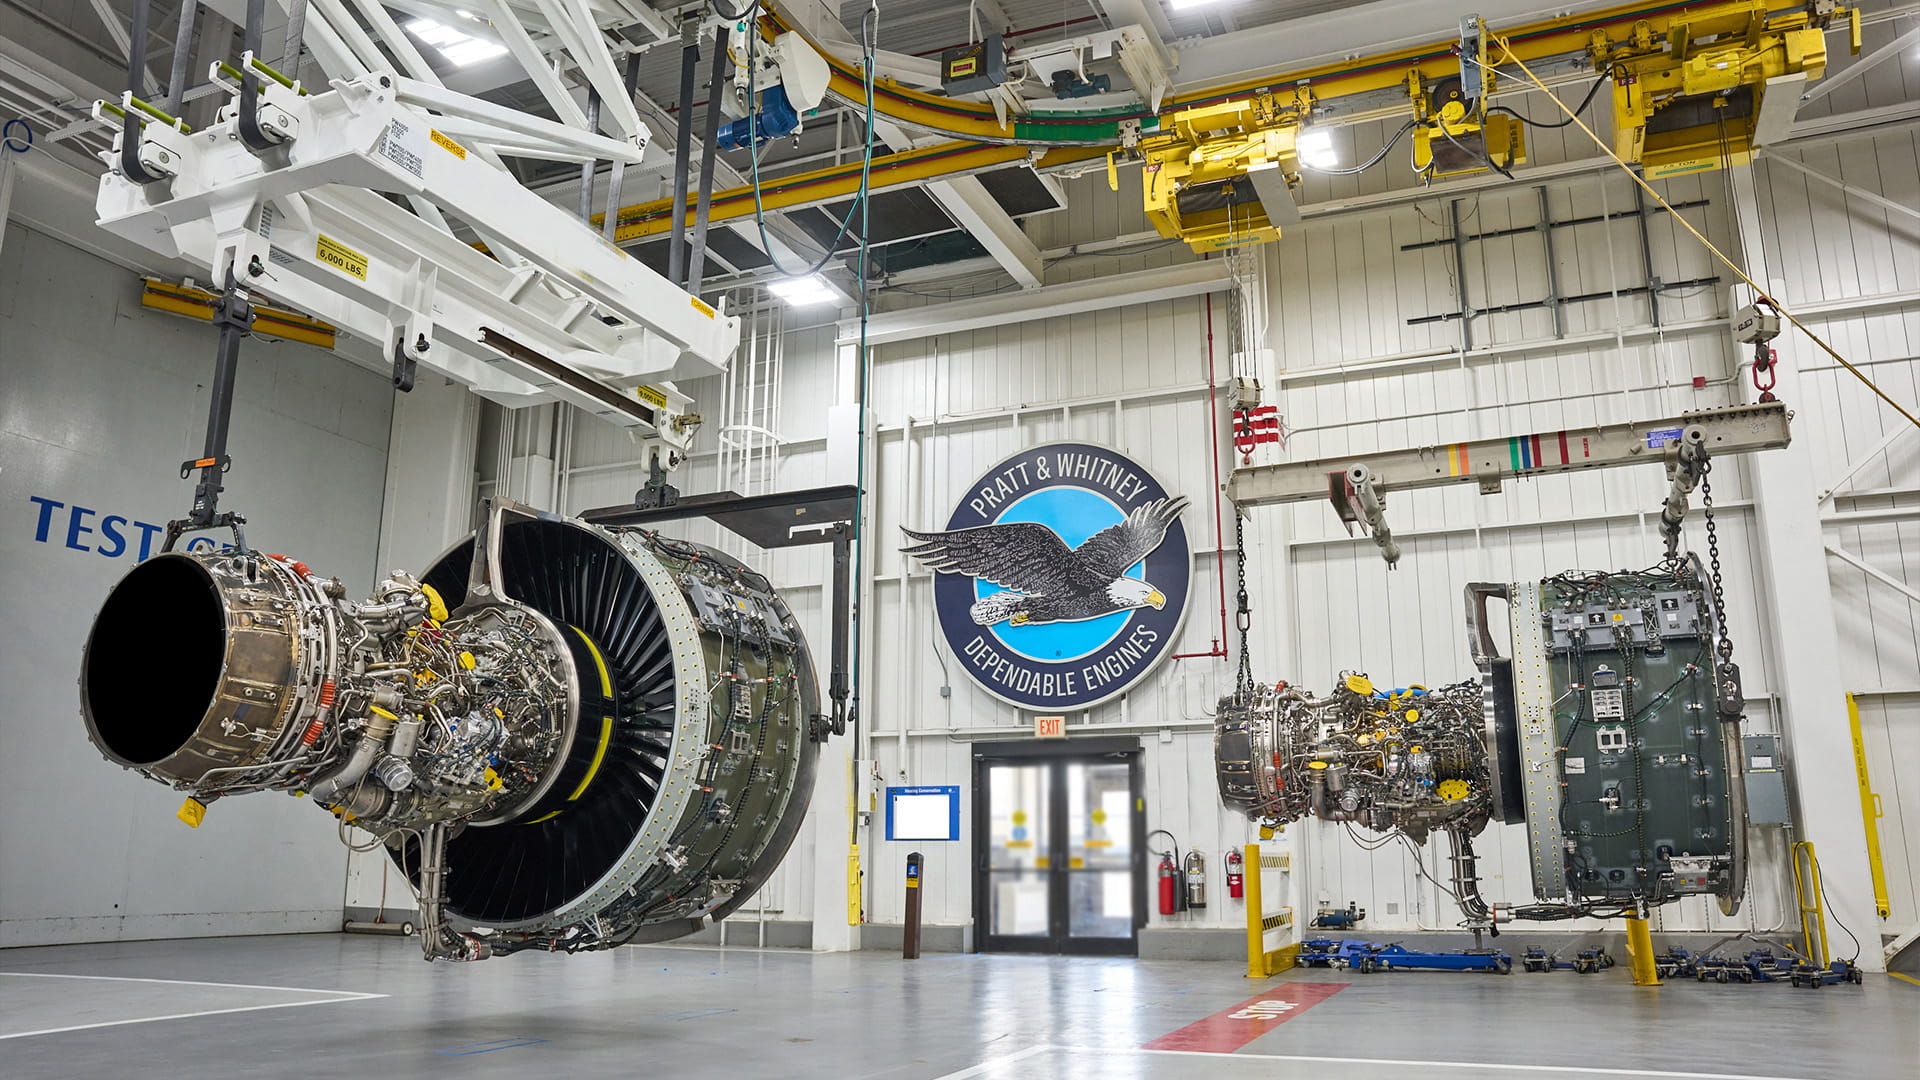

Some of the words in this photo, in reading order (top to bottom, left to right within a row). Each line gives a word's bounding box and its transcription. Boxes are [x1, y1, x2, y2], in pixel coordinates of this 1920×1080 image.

[431, 130, 466, 159] REVERSE
[319, 249, 344, 267] 6,000
[345, 262, 364, 277] LBS.
[970, 462, 1030, 518] PRATT
[1036, 456, 1051, 481] &
[1057, 453, 1148, 503] WHITNEY
[30, 496, 163, 564] TEST
[964, 635, 1077, 697] DEPENDABLE
[1083, 624, 1159, 690] ENGINES
[1039, 719, 1060, 736] EXIT
[1227, 1000, 1300, 1020] STOP
